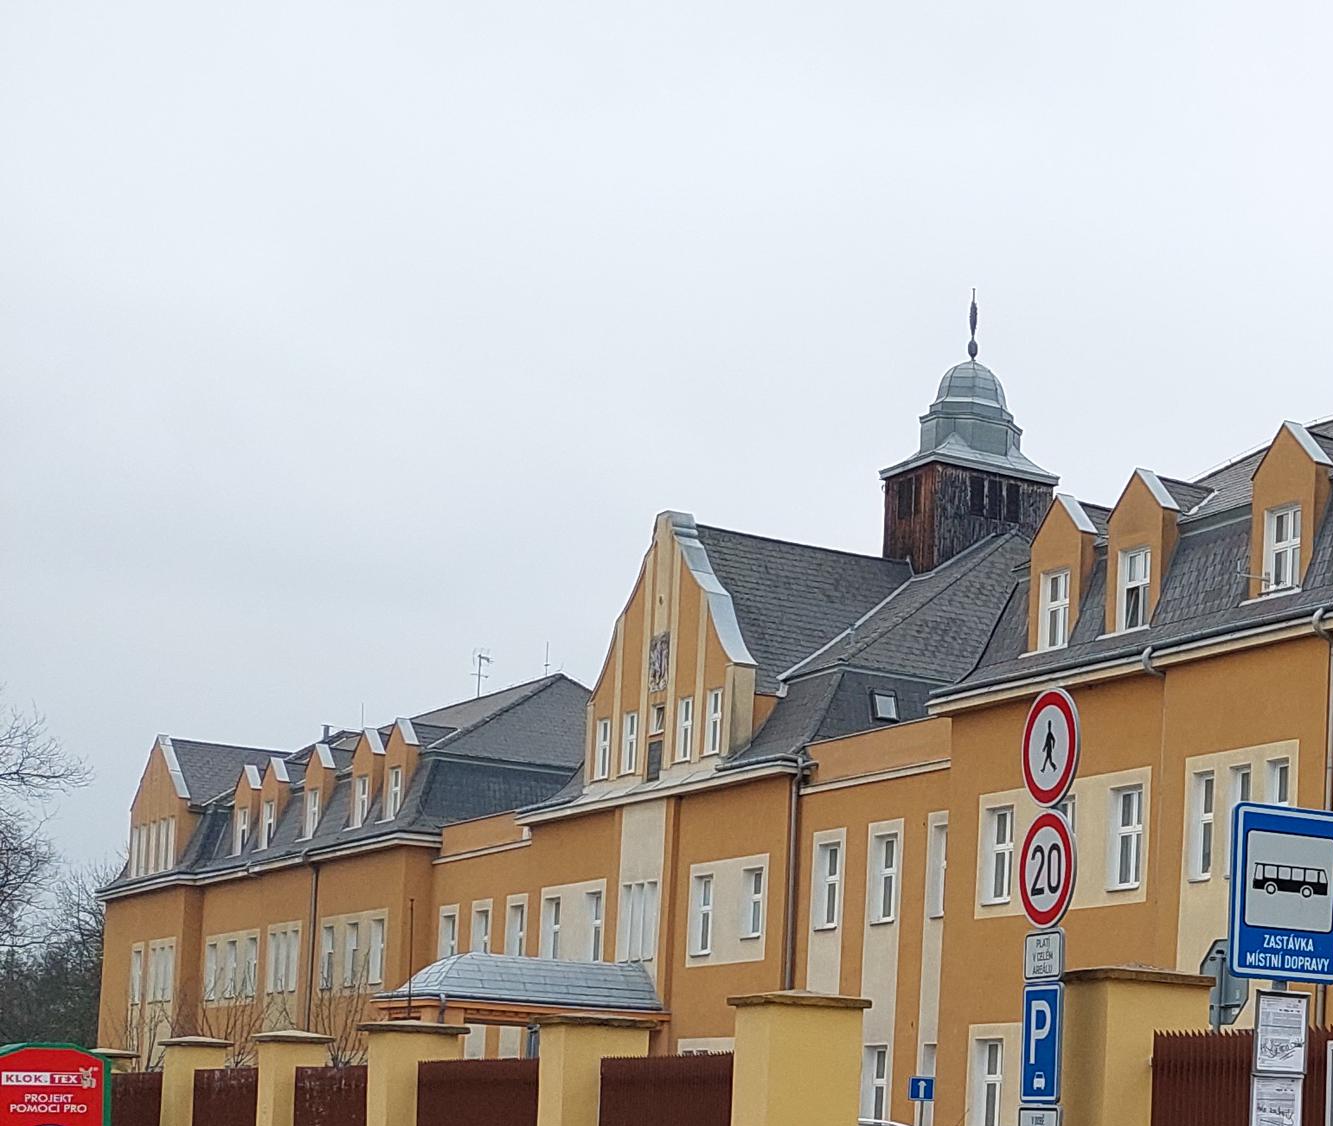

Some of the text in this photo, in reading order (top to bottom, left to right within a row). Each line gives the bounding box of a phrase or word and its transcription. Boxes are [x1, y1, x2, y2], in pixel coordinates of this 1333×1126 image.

[1031, 843, 1061, 896] 20
[1263, 934, 1314, 951] ZASTÁVKA
[1246, 950, 1329, 972] MÍSTNÍ DOPRAVY
[1029, 1000, 1051, 1064] P
[54, 1074, 78, 1083] TEX
[25, 1094, 73, 1102] PROJEKT
[10, 1104, 87, 1113] POMOCI PRO
